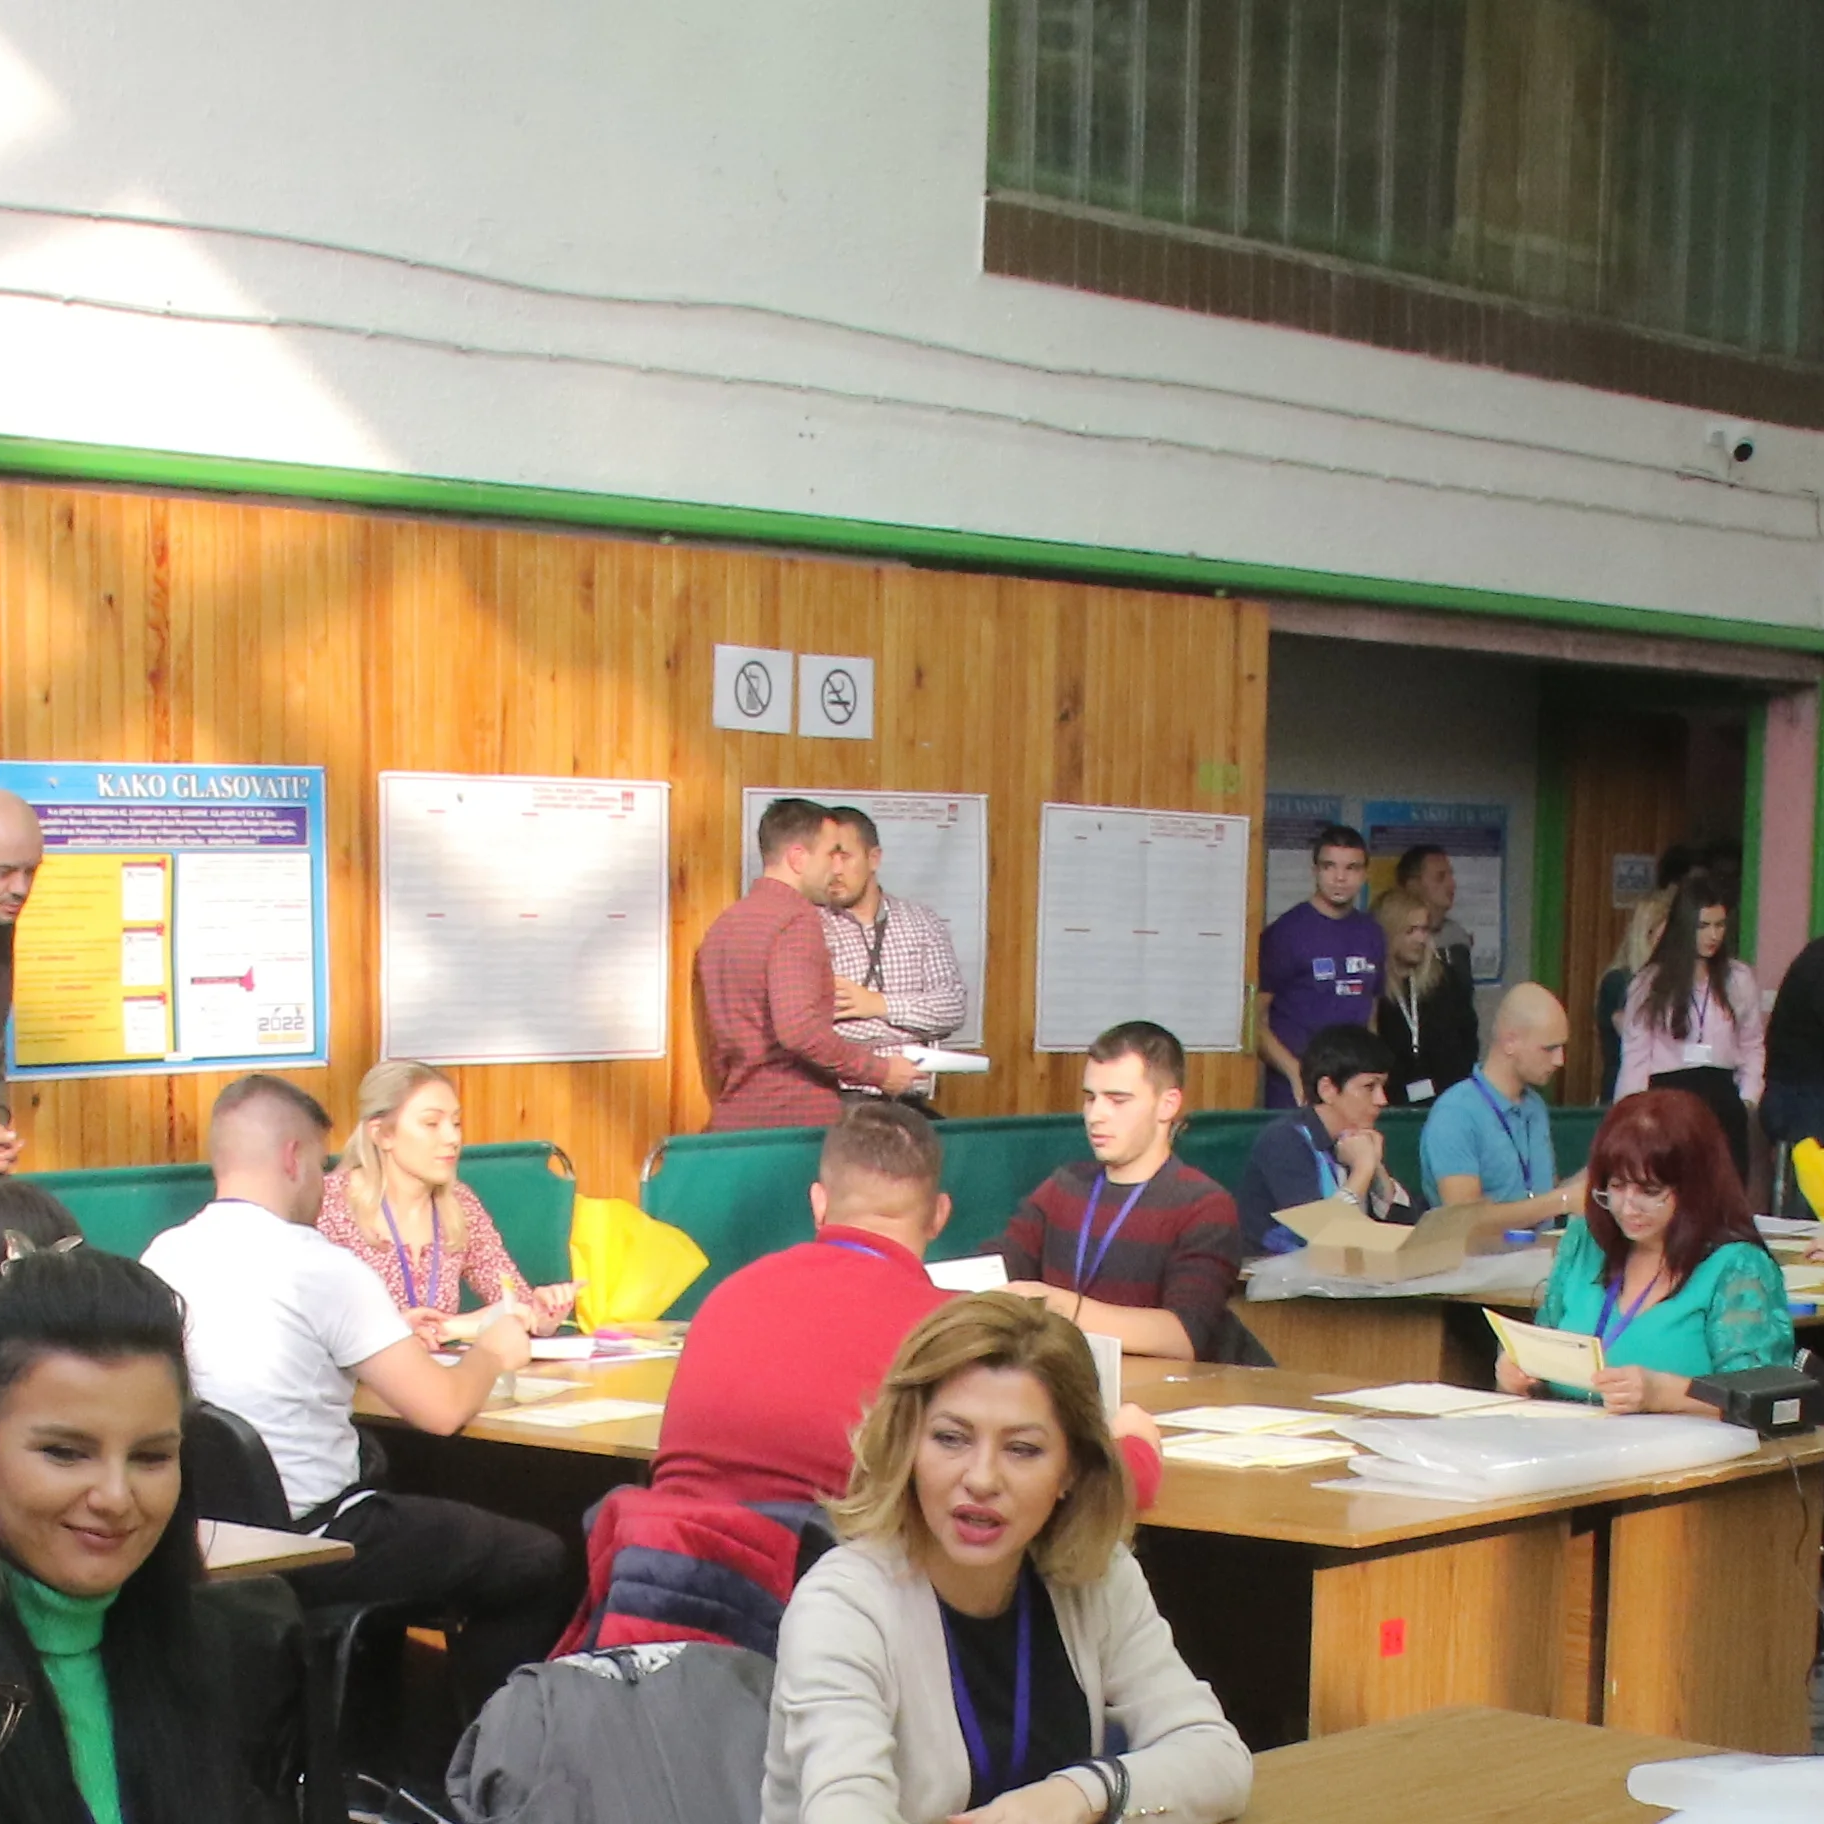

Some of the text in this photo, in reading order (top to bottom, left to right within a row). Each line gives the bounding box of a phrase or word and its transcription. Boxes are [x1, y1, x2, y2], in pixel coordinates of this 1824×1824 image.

[97, 773, 311, 800] KAKO GLASOVATI?
[257, 1015, 305, 1032] 2022
